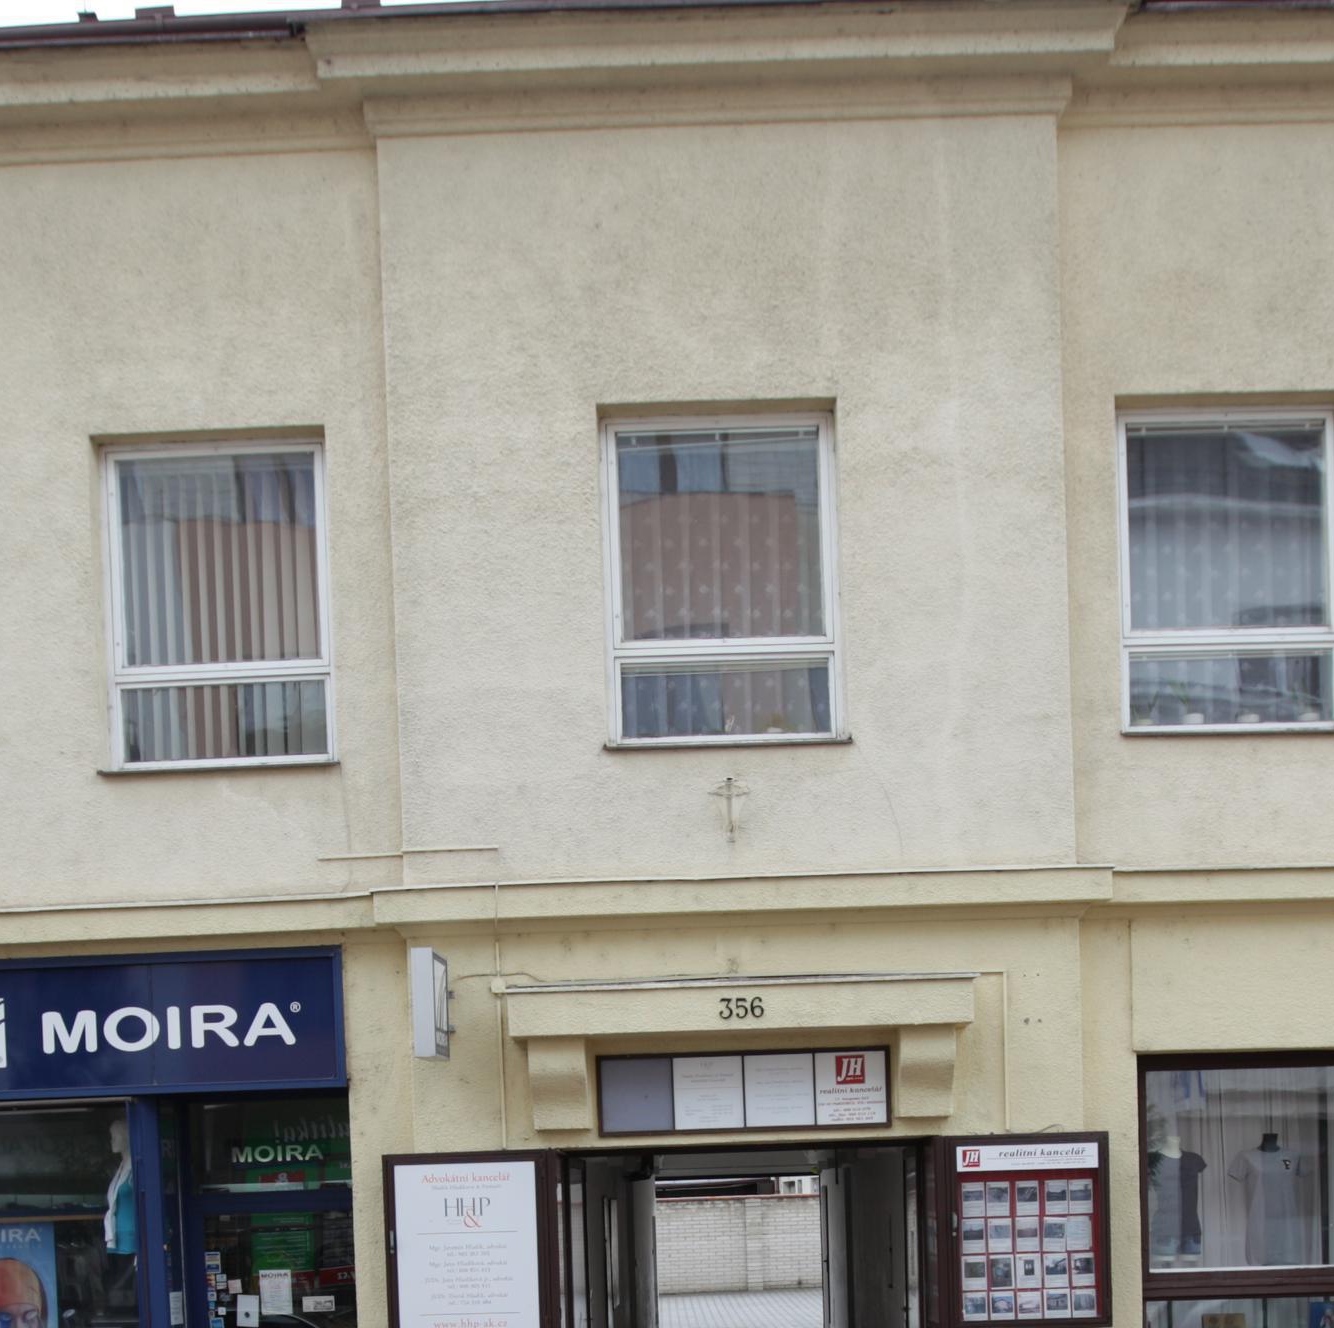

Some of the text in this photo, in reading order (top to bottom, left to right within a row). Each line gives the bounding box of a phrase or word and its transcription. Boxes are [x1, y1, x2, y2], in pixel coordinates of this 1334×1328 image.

[719, 996, 764, 1019] 356
[837, 1057, 863, 1082] JH
[231, 1144, 324, 1163] MOIRA
[422, 1171, 510, 1184] Advokátní kancelář
